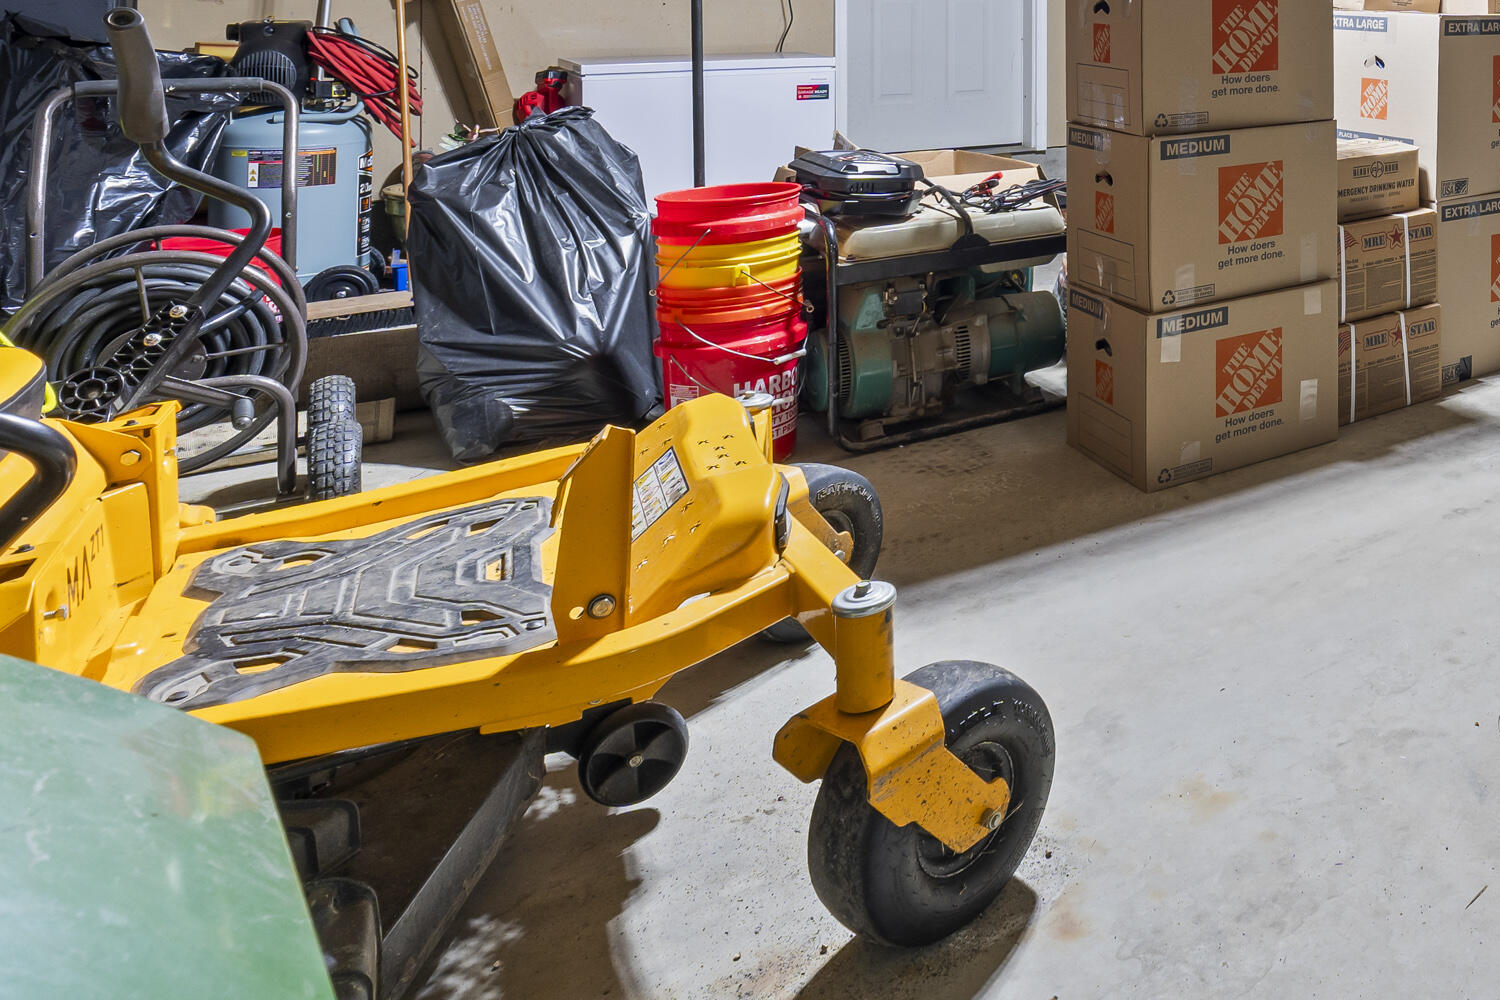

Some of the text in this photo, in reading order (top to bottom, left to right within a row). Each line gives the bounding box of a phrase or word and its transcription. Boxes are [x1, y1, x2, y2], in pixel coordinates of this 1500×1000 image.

[1218, 4, 1247, 34] THE
[1333, 18, 1384, 29] XTRA LARGE
[1448, 22, 1480, 32] EXTRA
[1239, 24, 1278, 72] DEPOT
[1221, 73, 1271, 84] How doers
[1212, 84, 1280, 98] get more done.
[1072, 131, 1103, 150] MEDIU
[1166, 139, 1225, 156] MEDIUM
[1225, 173, 1253, 204] THE
[1337, 186, 1368, 198] MERGENCY
[1369, 182, 1396, 193] DRINKING
[1397, 179, 1415, 188] WATER
[1218, 161, 1283, 243] HOME
[1445, 205, 1477, 219] EXTRA
[1245, 189, 1283, 239] DEPOT
[1227, 240, 1276, 255] How doers
[1363, 226, 1432, 248] MRE STAR
[1218, 251, 1285, 270] get more done.
[1162, 311, 1223, 334] MEDIUM
[1365, 322, 1435, 347] MRE STAR
[1222, 343, 1250, 376] THE
[734, 365, 797, 399] HARBO
[1216, 329, 1282, 416] HOME
[1242, 355, 1282, 410] DEPOT
[1225, 409, 1274, 427] How doers
[1215, 418, 1285, 443] get more done.
